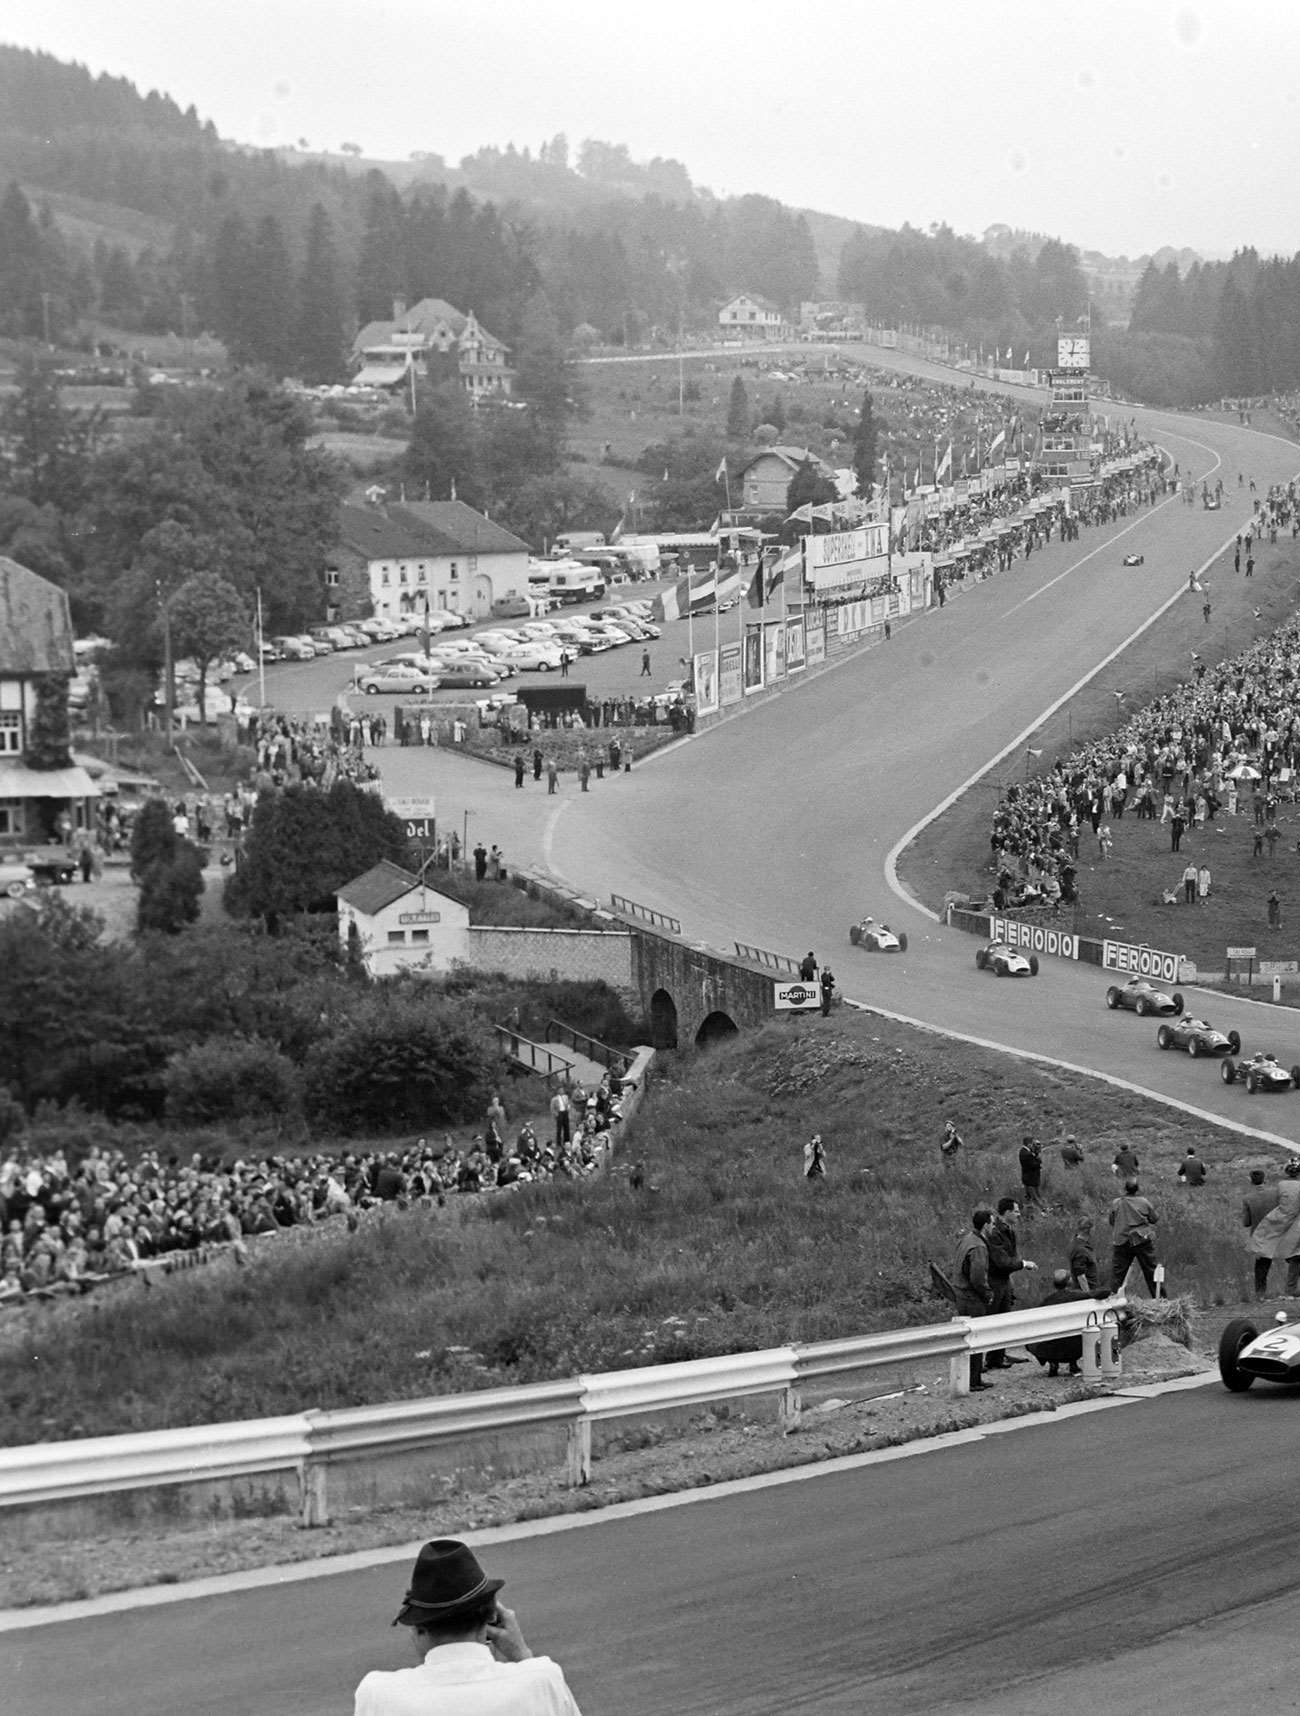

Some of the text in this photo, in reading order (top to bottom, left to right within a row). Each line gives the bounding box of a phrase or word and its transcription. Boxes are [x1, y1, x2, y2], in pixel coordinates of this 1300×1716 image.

[996, 919, 1072, 957] FERODO
[1107, 944, 1173, 979] FERODO
[780, 991, 815, 1000] MARTINI
[1264, 1337, 1288, 1350] 2
